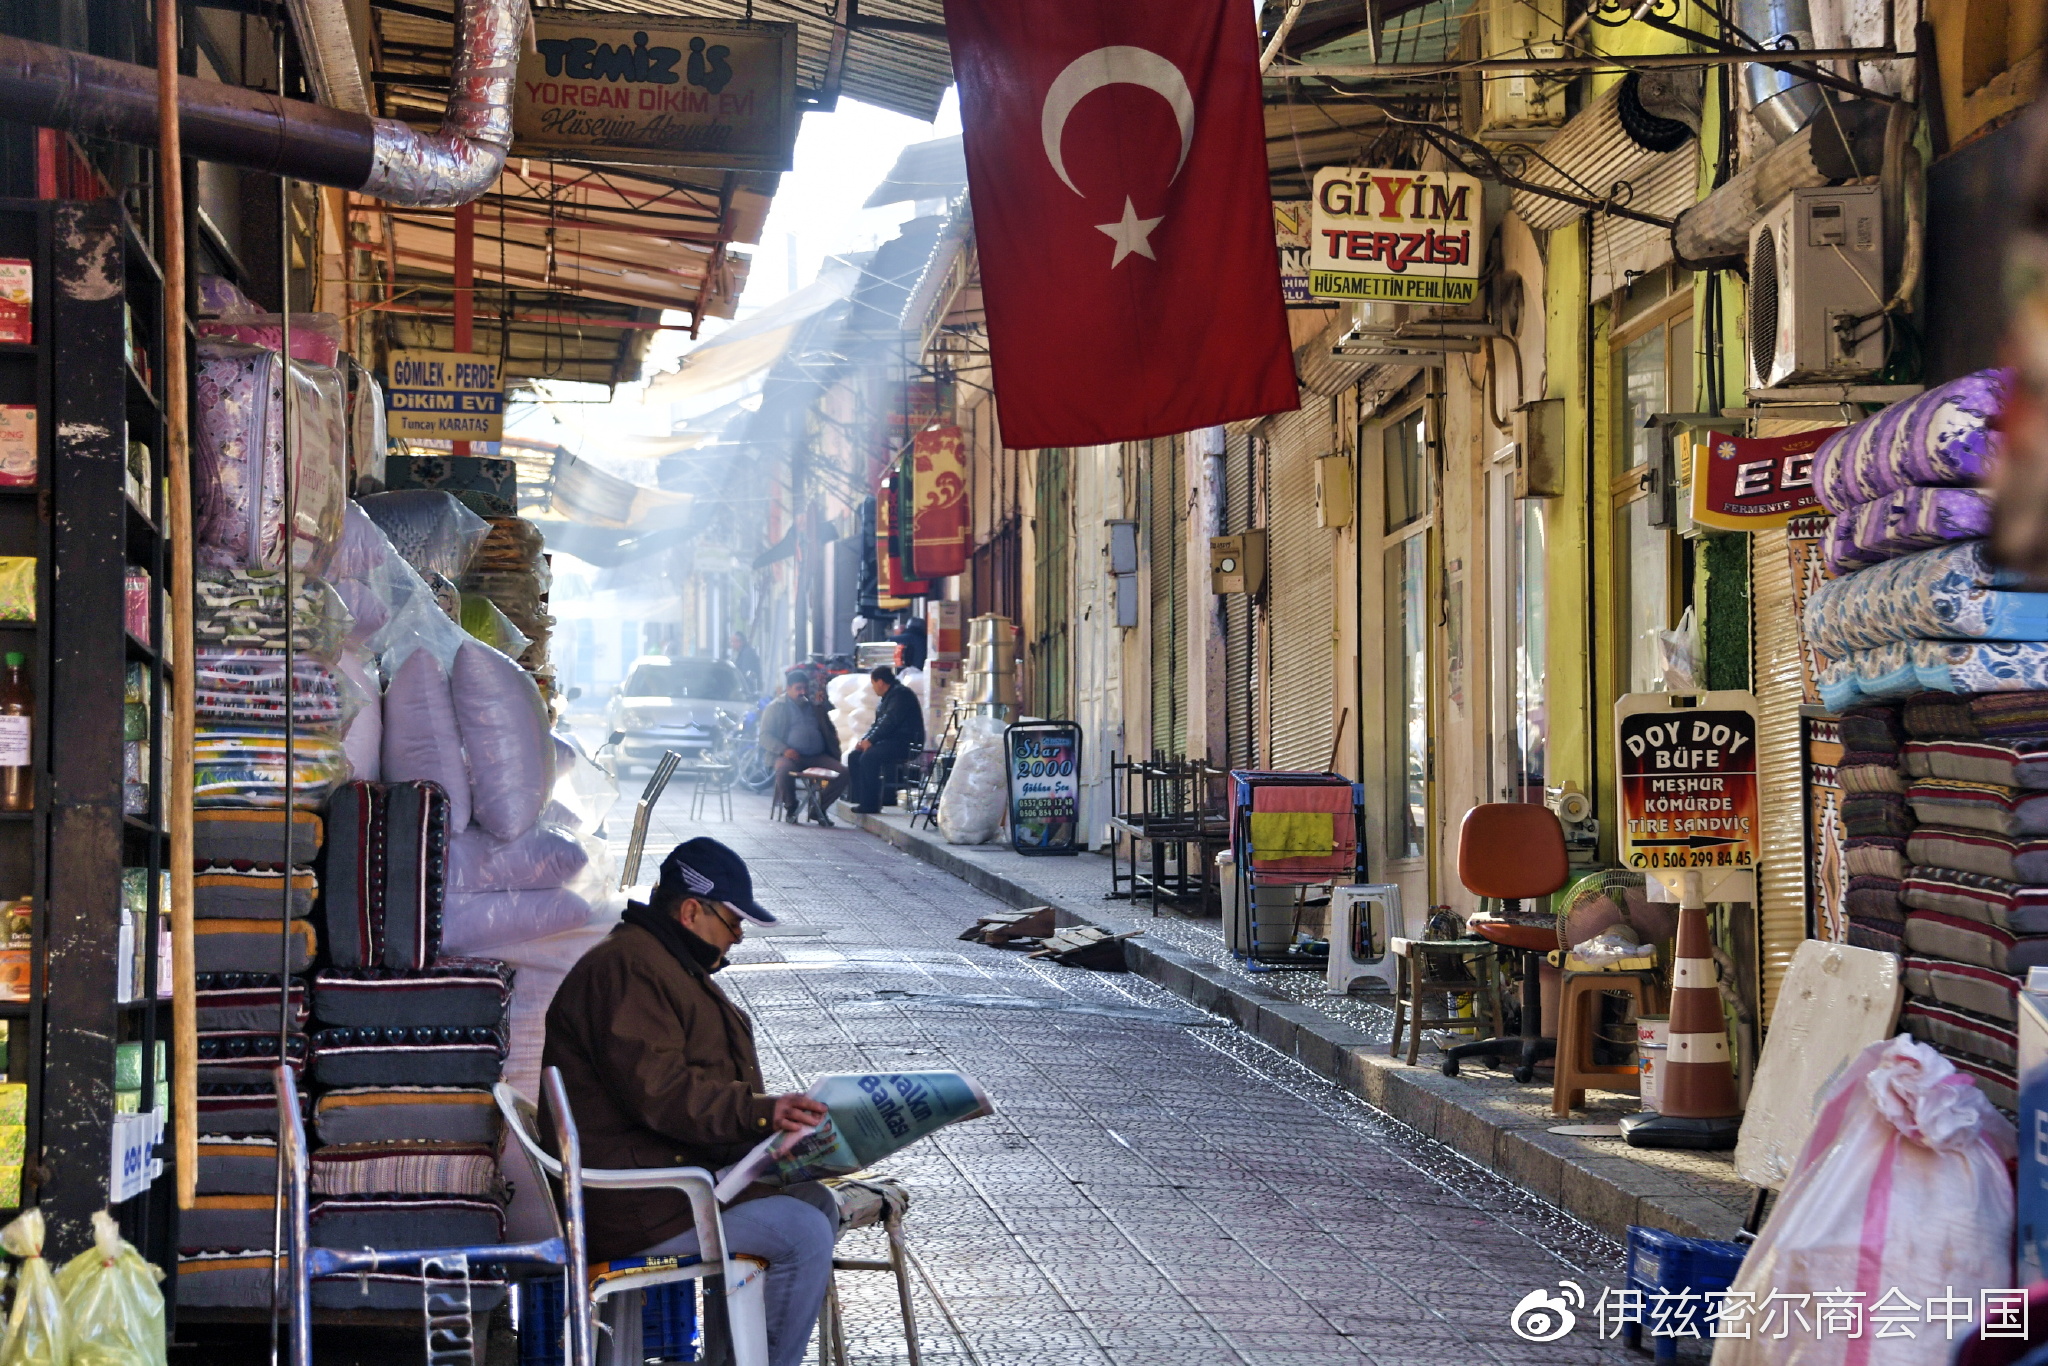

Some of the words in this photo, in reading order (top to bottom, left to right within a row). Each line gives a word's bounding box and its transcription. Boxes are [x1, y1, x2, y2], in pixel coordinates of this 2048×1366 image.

[536, 31, 682, 85] TEMİZ
[687, 36, 733, 94] İŞ
[524, 81, 630, 109] YORGAN
[638, 84, 709, 114] DİKİM
[718, 90, 755, 116] EVİ
[540, 108, 637, 144] Hüseyin
[1319, 171, 1471, 220] GİYİM
[1321, 228, 1470, 273] TERZİSİ
[1314, 273, 1403, 297] HÜSAMETTİN
[394, 356, 445, 387] GÖMLEK
[456, 363, 496, 389] PERDE
[392, 393, 454, 410] DİKİM
[462, 395, 496, 411] EVİ
[402, 416, 437, 434] Tuncay
[440, 418, 489, 434] KARATAŞ
[1722, 500, 1792, 514] FERMENTE
[1016, 738, 1060, 758] Star
[1625, 720, 1680, 758] DOY
[1692, 720, 1749, 754] DOY
[1656, 747, 1719, 770] BÜFE
[1017, 760, 1073, 780] 2000
[1652, 777, 1724, 795] MEŞHUR
[1645, 796, 1732, 813] KÖMÜRDE
[1628, 817, 1669, 833] TİRE
[1674, 814, 1750, 833] SANDVİÇ
[1651, 853, 1659, 868] 0
[1663, 853, 1686, 867] 506
[1690, 852, 1713, 867] 299
[1717, 851, 1732, 866] 84
[1736, 851, 1751, 865] 45
